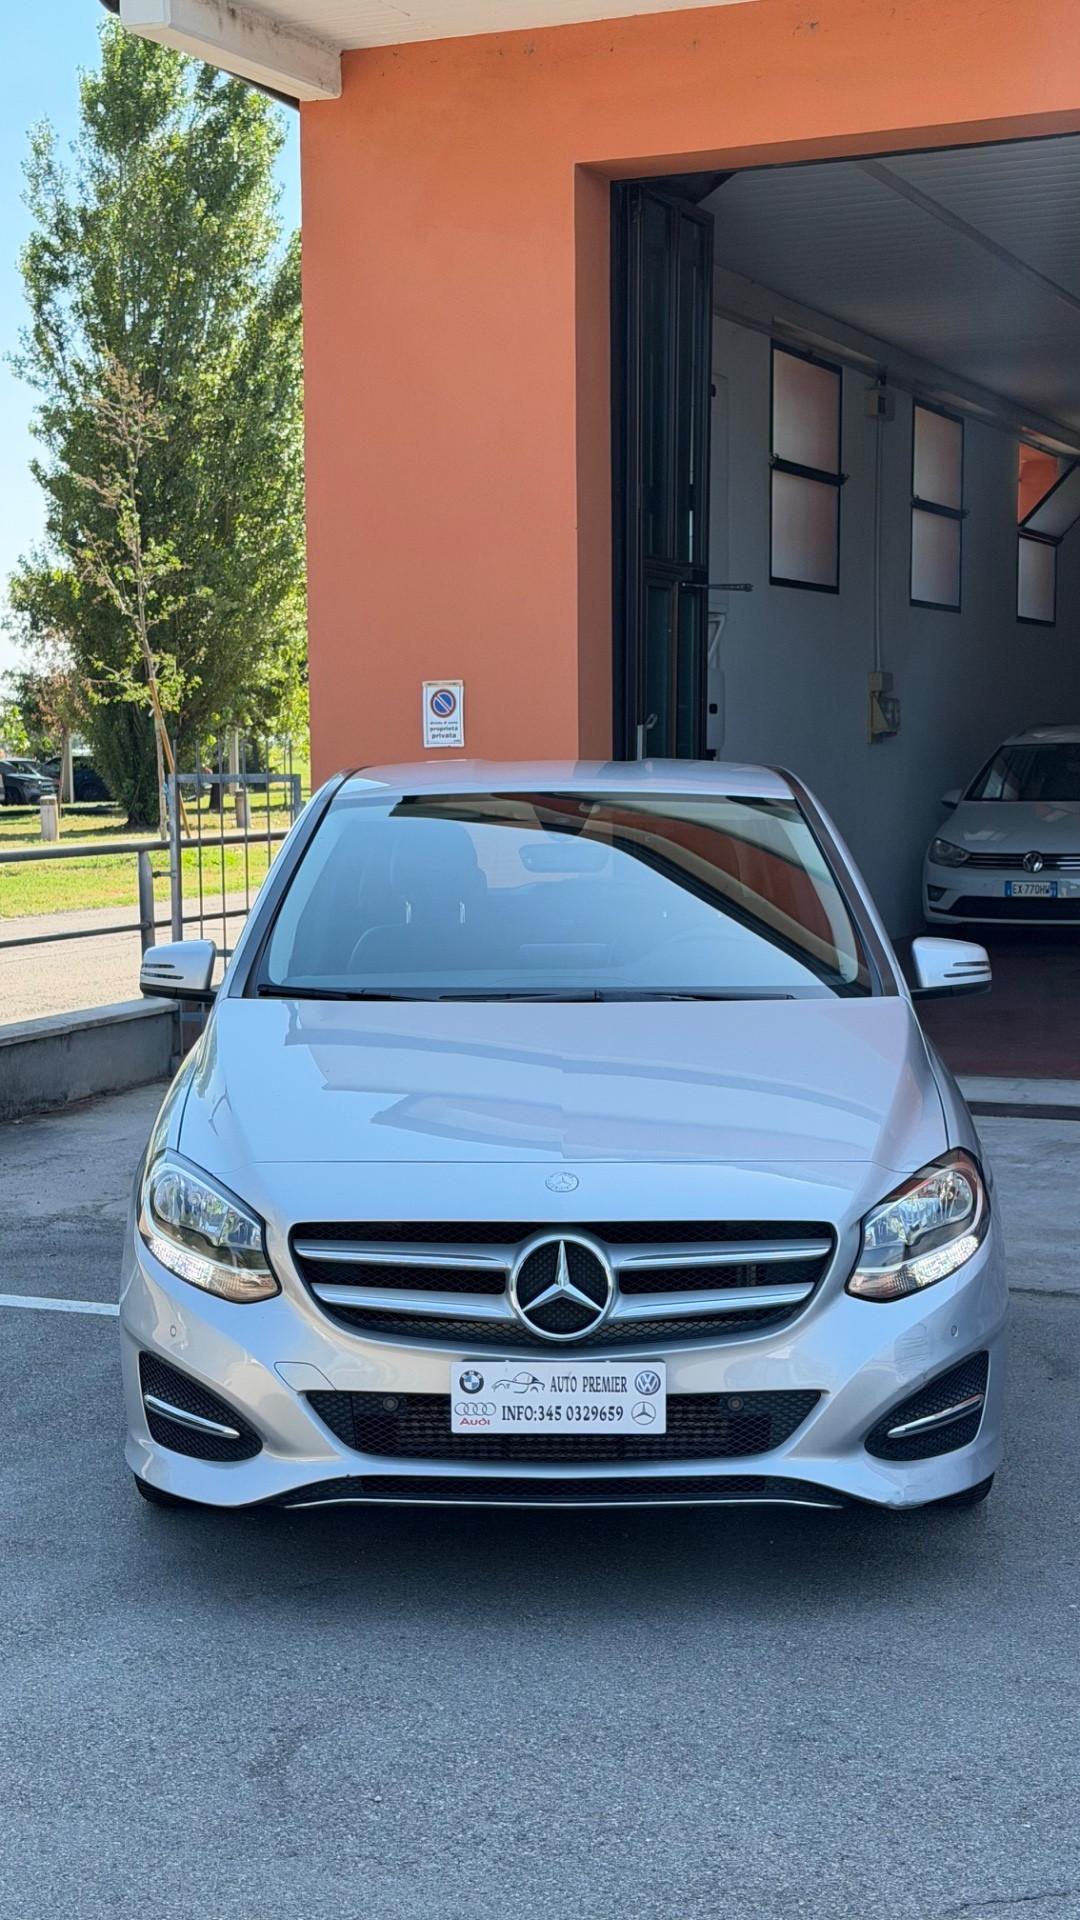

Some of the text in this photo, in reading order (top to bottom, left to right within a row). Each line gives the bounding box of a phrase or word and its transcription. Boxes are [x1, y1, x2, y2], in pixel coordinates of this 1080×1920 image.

[550, 1376, 628, 1392] AUTO PREMIER
[460, 1417, 490, 1425] Audi
[502, 1405, 624, 1422] INFO:345 0329659
